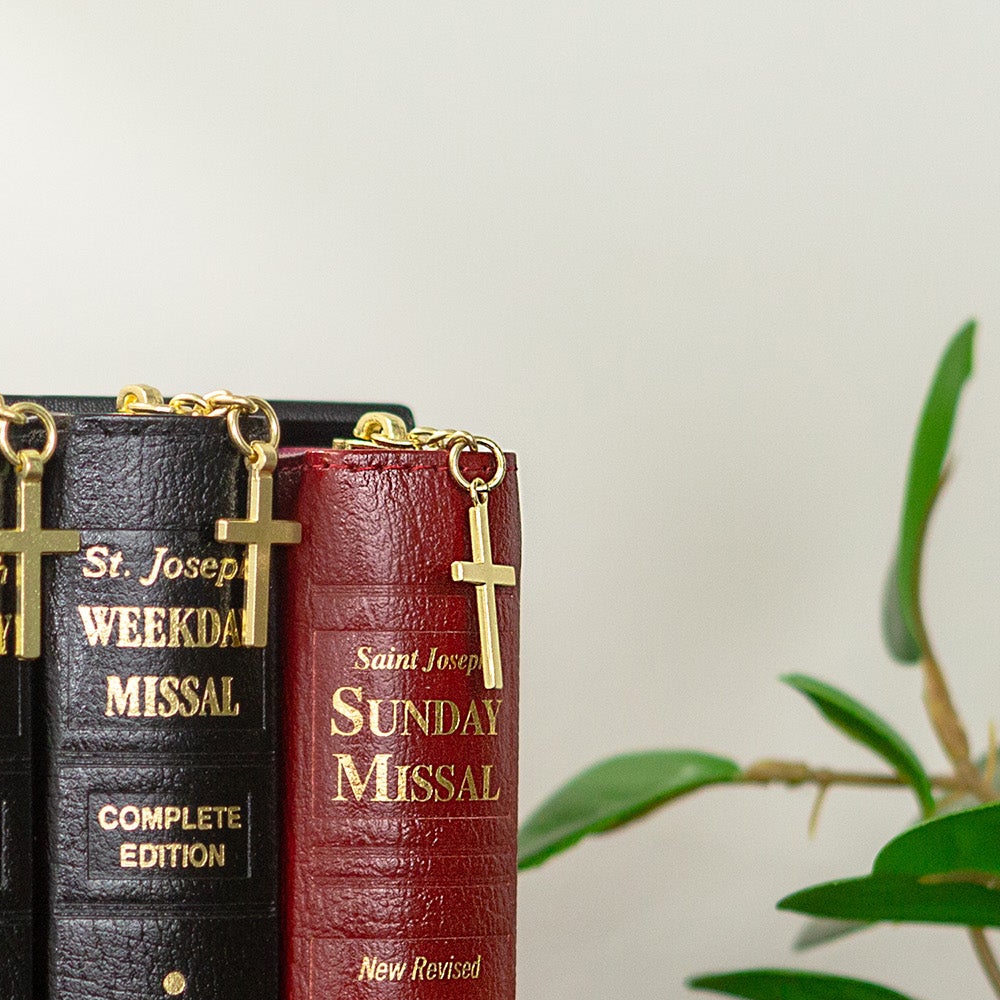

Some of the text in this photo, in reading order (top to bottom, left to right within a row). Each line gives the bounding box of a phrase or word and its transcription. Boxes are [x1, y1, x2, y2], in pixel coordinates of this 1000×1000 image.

[83, 546, 247, 588] St. Josep
[78, 605, 241, 648] WEEKDA
[354, 646, 484, 676] Saint Josep
[105, 674, 240, 717] MISSAL
[330, 686, 503, 737] SUNDAY
[331, 753, 501, 802] MISSAL
[98, 805, 242, 830] COMPLETE
[119, 843, 225, 868] EDITION
[357, 954, 482, 981] New Revised
